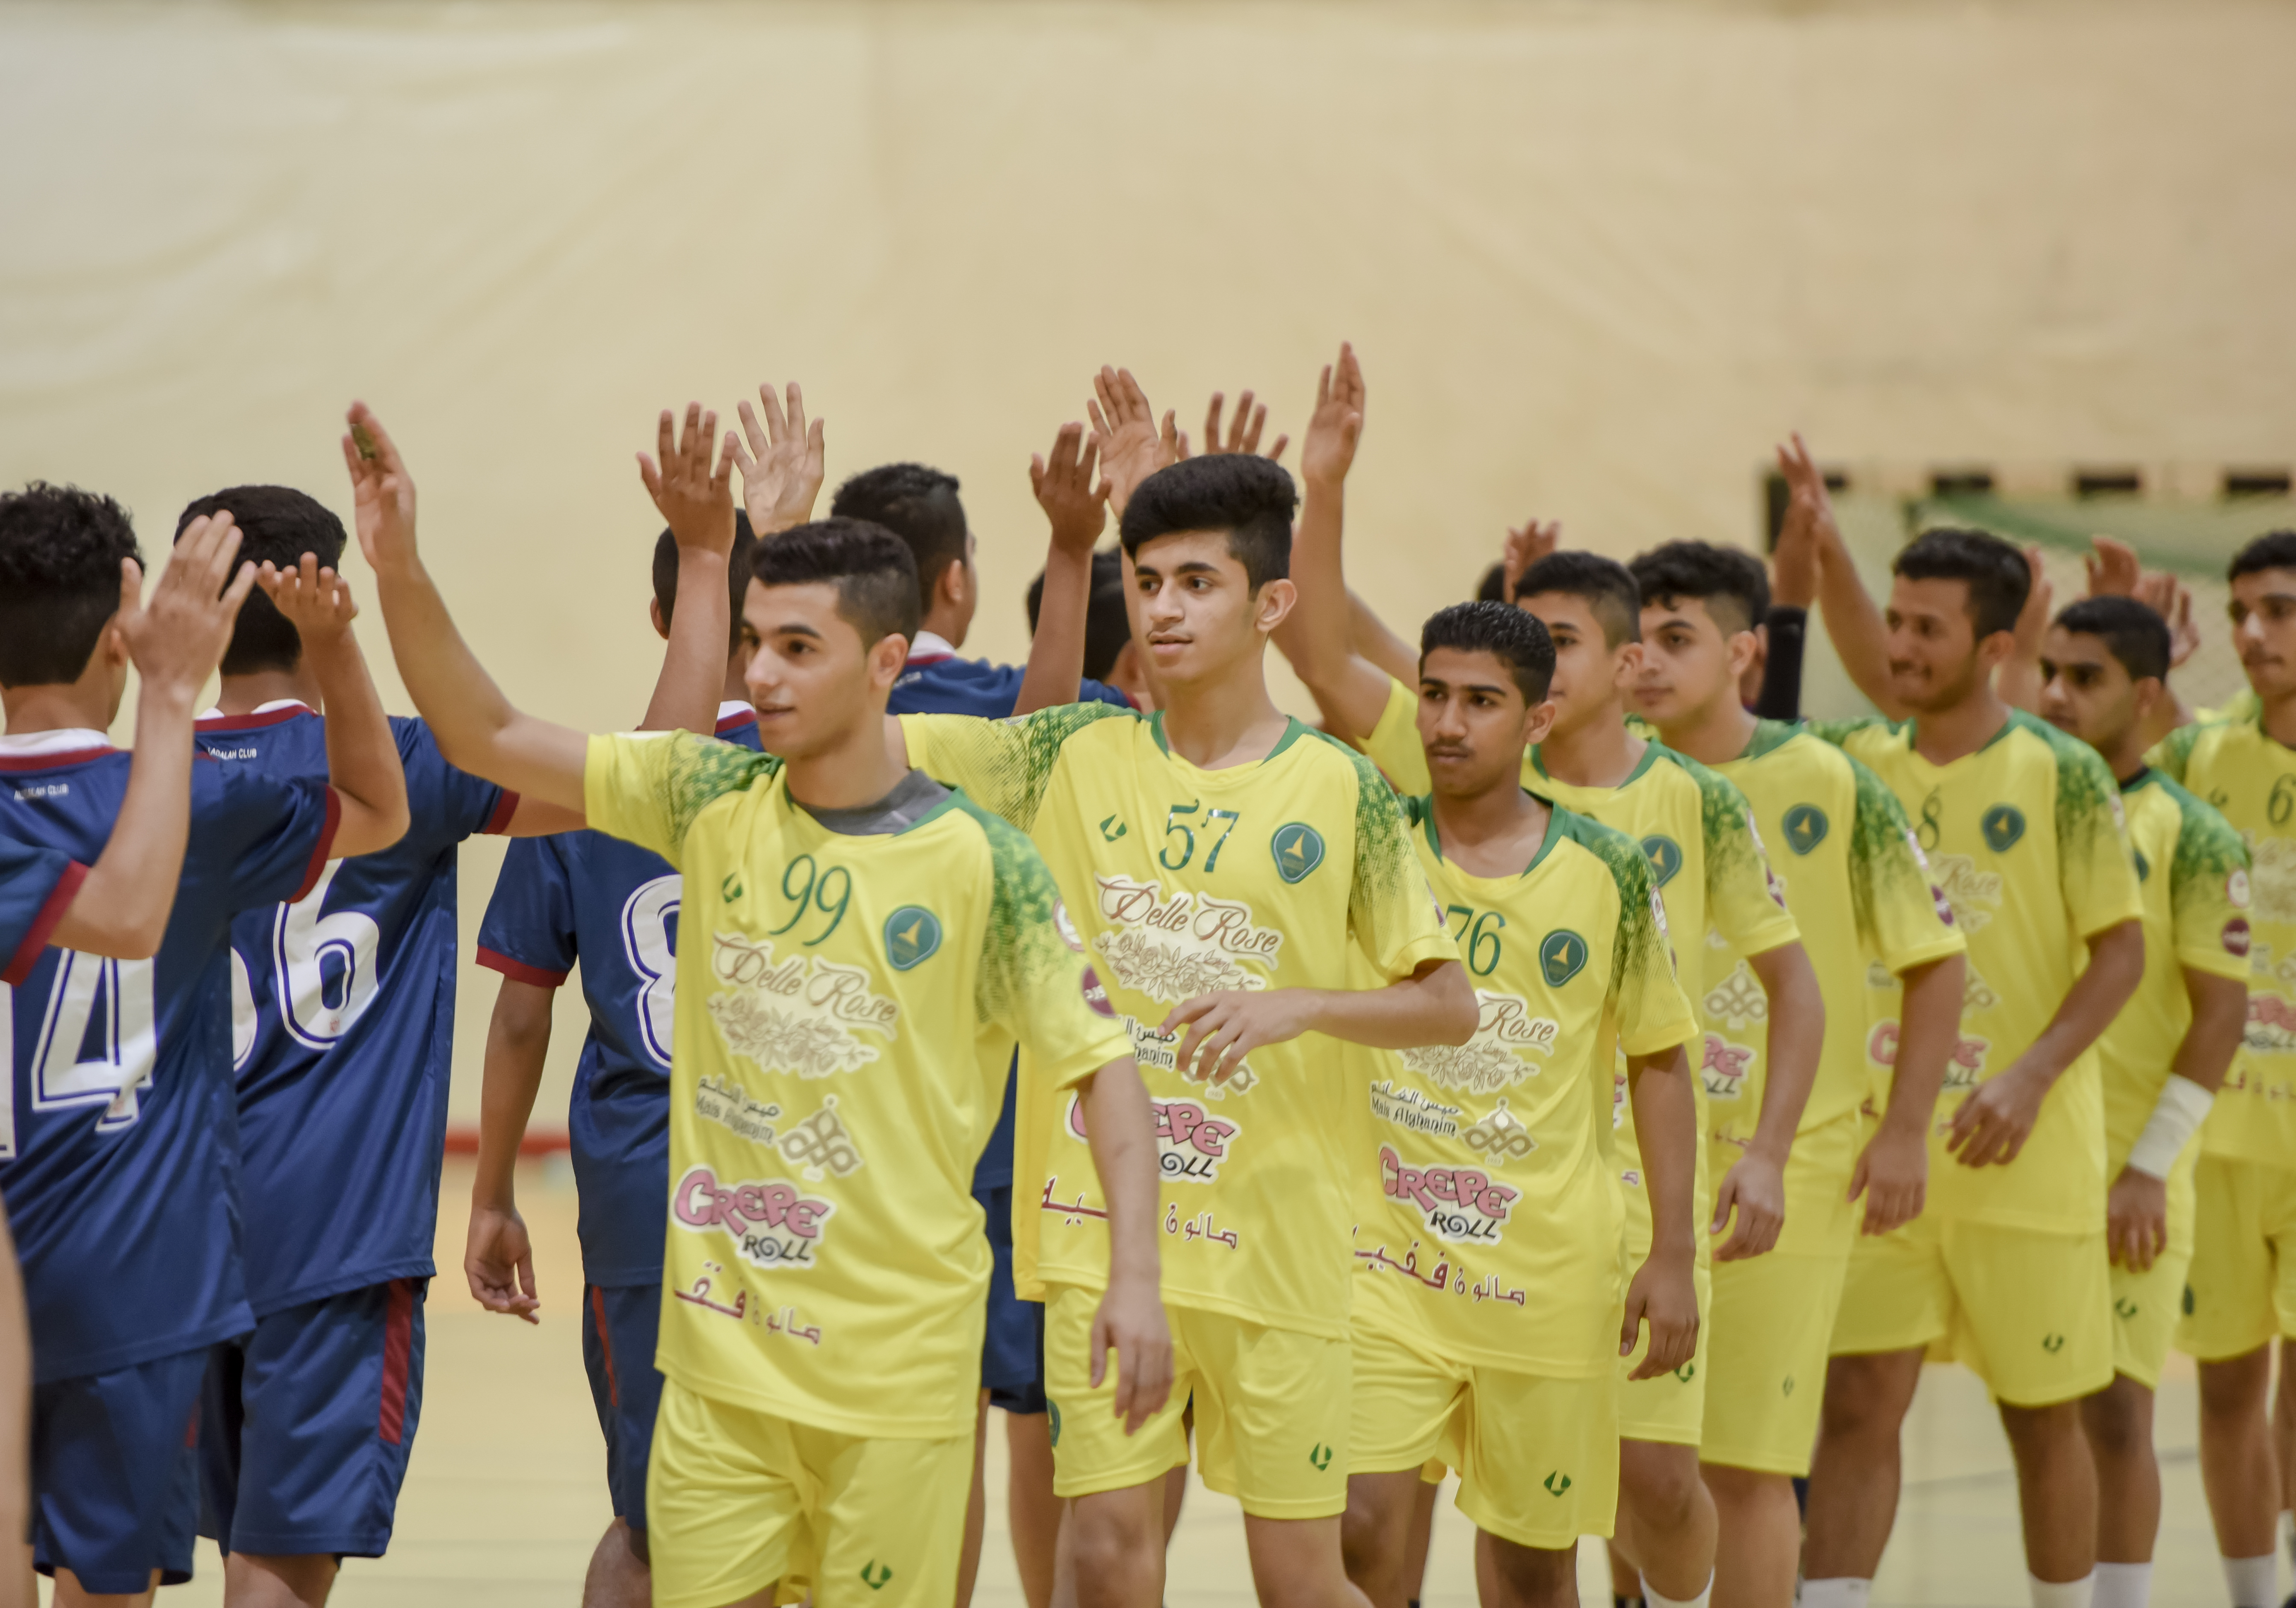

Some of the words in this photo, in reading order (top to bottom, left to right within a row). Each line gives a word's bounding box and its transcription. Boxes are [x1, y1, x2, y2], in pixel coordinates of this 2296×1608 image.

[238, 748, 257, 759] CLUB
[1159, 799, 1240, 872] 57
[768, 854, 851, 946] 99
[1193, 896, 1280, 965] Rose
[1446, 903, 1506, 977] 76
[807, 956, 898, 1035] Rose
[1478, 992, 1556, 1049] Rose
[1134, 1043, 1174, 1069] hanim
[1393, 1106, 1456, 1137] Alghanim
[1159, 1152, 1213, 1178] OLL
[1379, 1146, 1518, 1218] CREPE
[674, 1169, 830, 1238] CREPE
[1430, 1211, 1499, 1239] ROLL
[743, 1234, 810, 1262] ROLL
